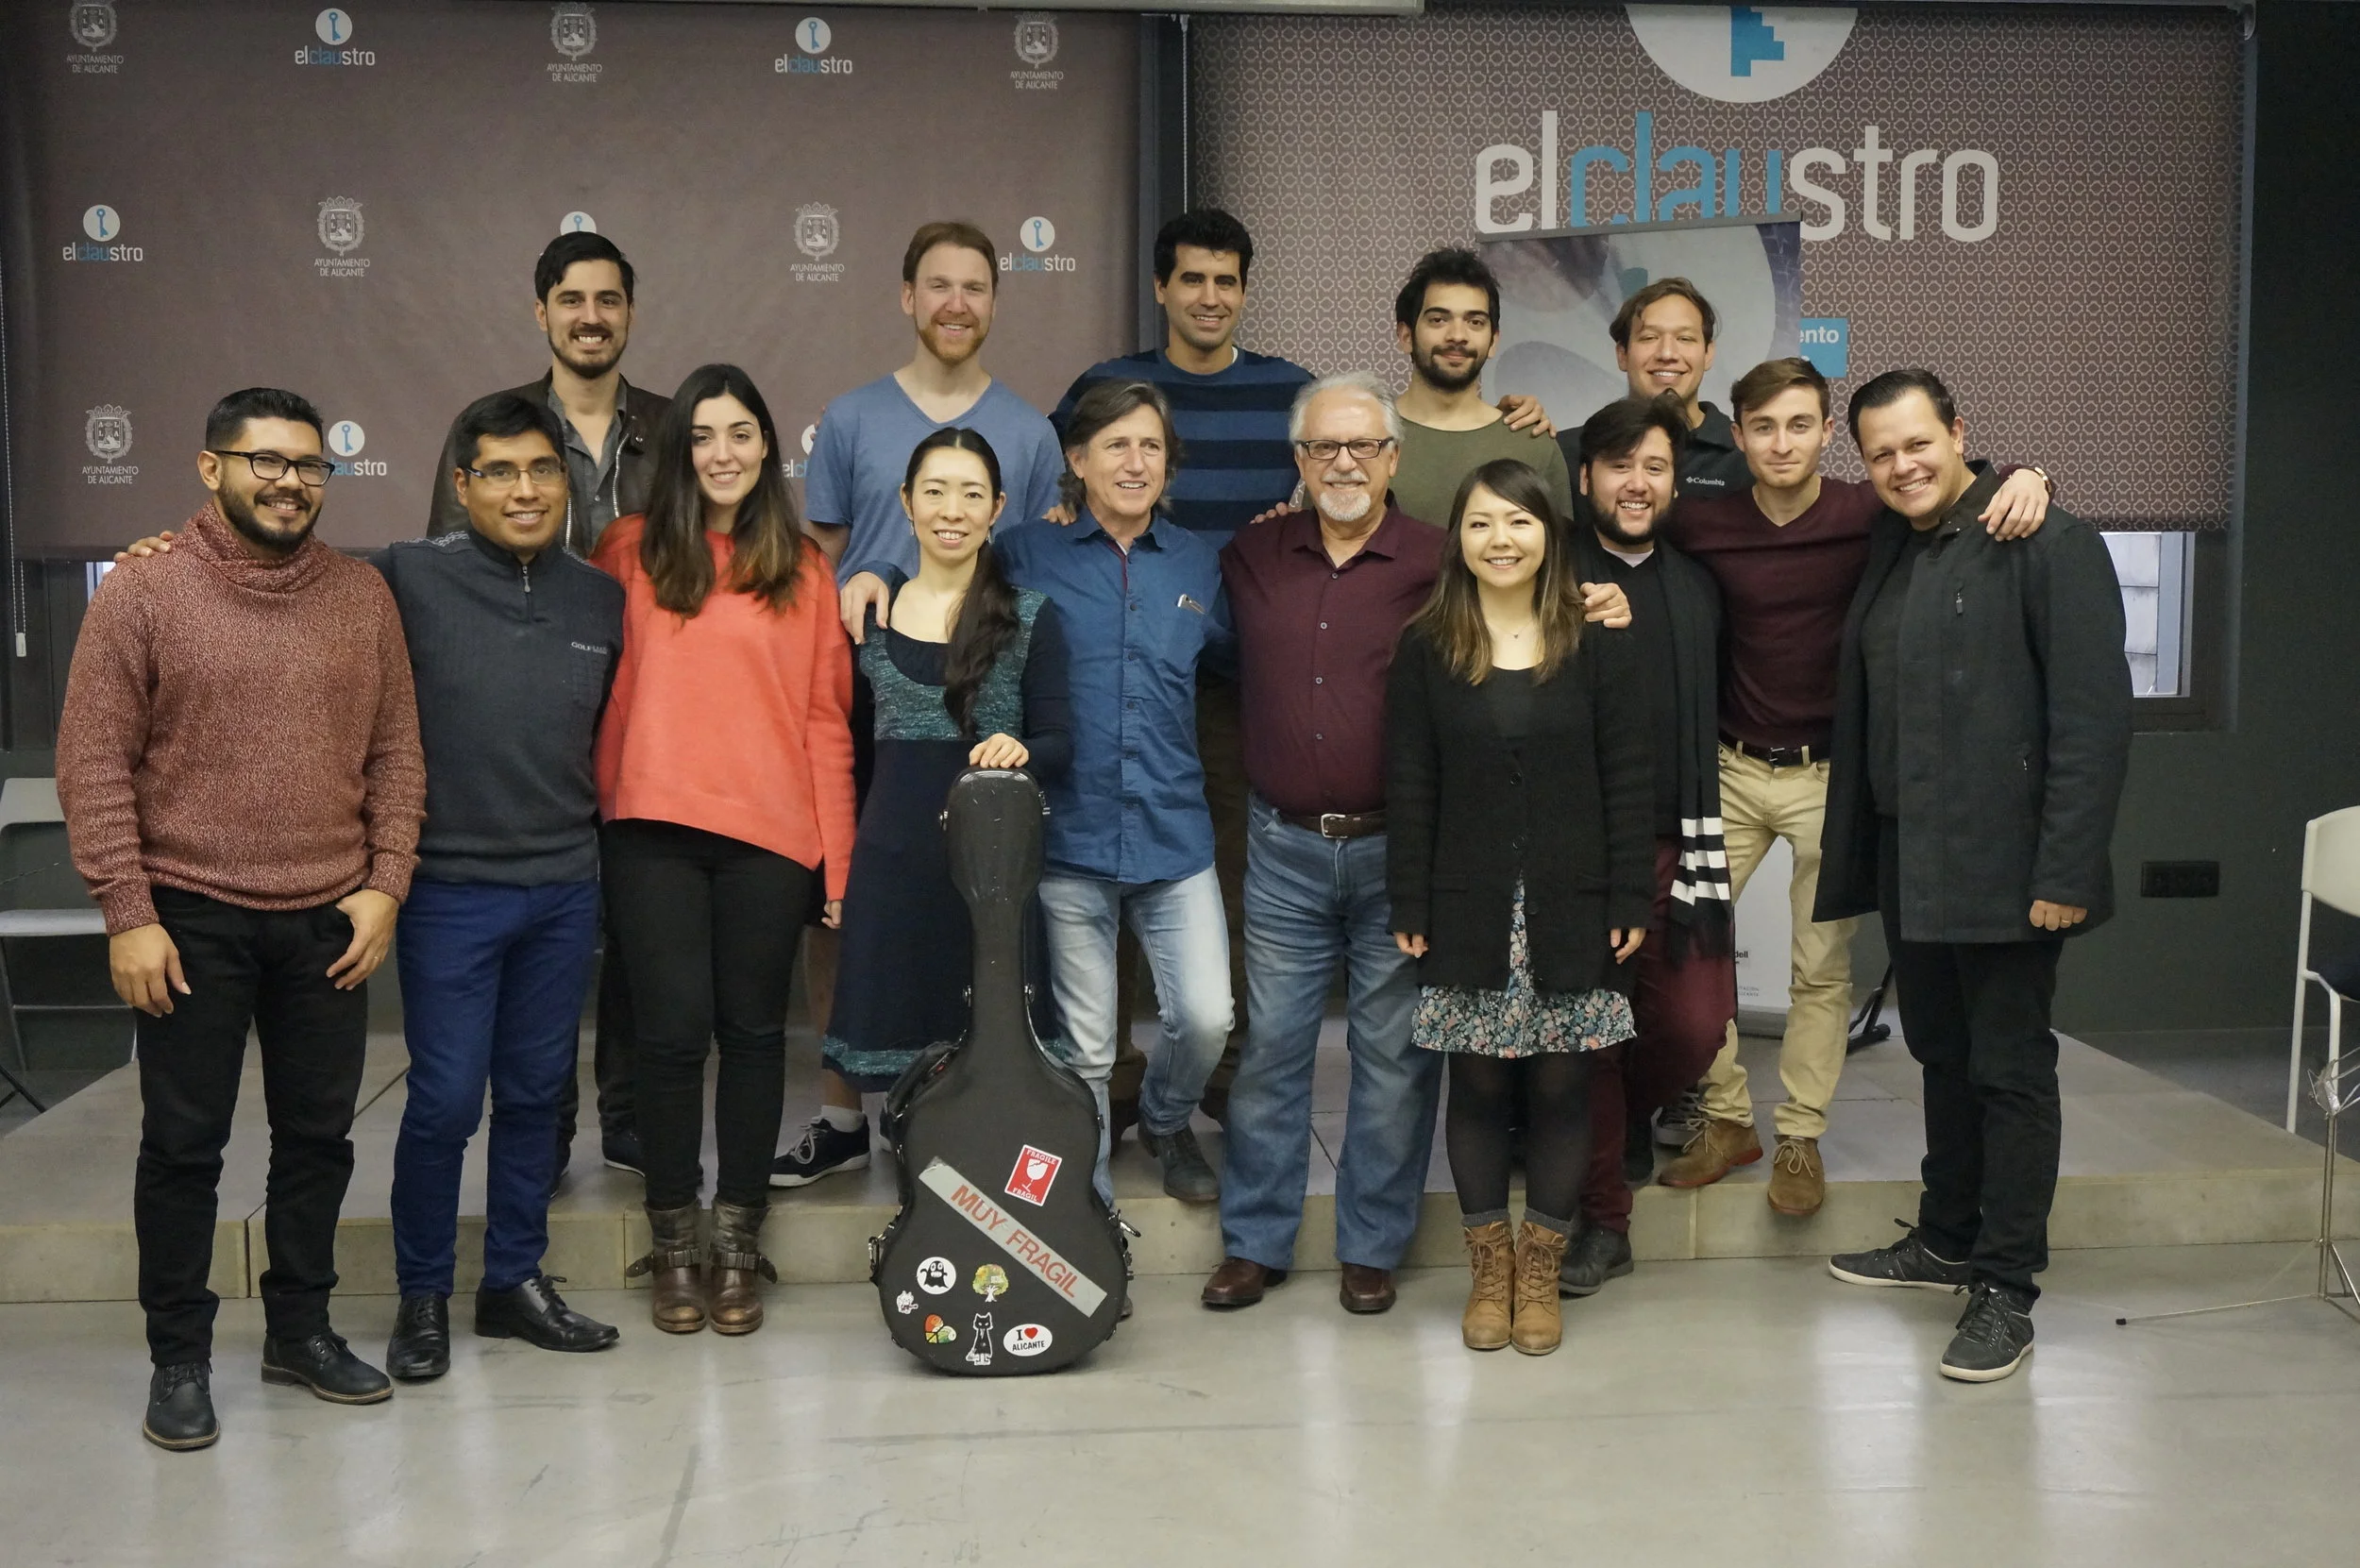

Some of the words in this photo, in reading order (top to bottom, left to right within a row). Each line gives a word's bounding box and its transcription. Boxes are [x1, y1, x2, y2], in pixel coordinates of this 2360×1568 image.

[295, 45, 376, 66] elclaustro
[547, 63, 602, 73] AYUNTAMIENTO
[774, 54, 852, 74] elclaustro
[552, 73, 562, 82] DE
[564, 73, 597, 82] ALICANTE
[1010, 71, 1064, 80] AYUNTAMIENTO
[1016, 80, 1024, 89] DE
[1026, 80, 1058, 90] ALICANTE
[1475, 110, 1998, 242] elclaustro
[62, 242, 143, 261] elclaustro
[314, 258, 370, 267] AYUNTAMIENTO
[1000, 252, 1076, 272] elclaustro
[320, 268, 329, 277] DE
[331, 268, 364, 277] ALICANTE
[790, 263, 845, 272] AYUNTAMIENTO
[796, 273, 804, 281] DE
[806, 273, 839, 281] ALICANTE
[82, 465, 139, 475] AYUNTAMIENTO
[329, 458, 387, 476] laustro
[88, 475, 97, 484] DE
[99, 475, 133, 484] ALICANTE
[1693, 477, 1726, 486] Columbia
[1026, 1149, 1056, 1165] FRAGILE
[1013, 1188, 1037, 1202] FRAGIL
[951, 1185, 1008, 1231] MUY
[1005, 1229, 1078, 1298] FRAGIL
[1016, 1329, 1023, 1340] I
[1012, 1340, 1045, 1351] ALICANTE
